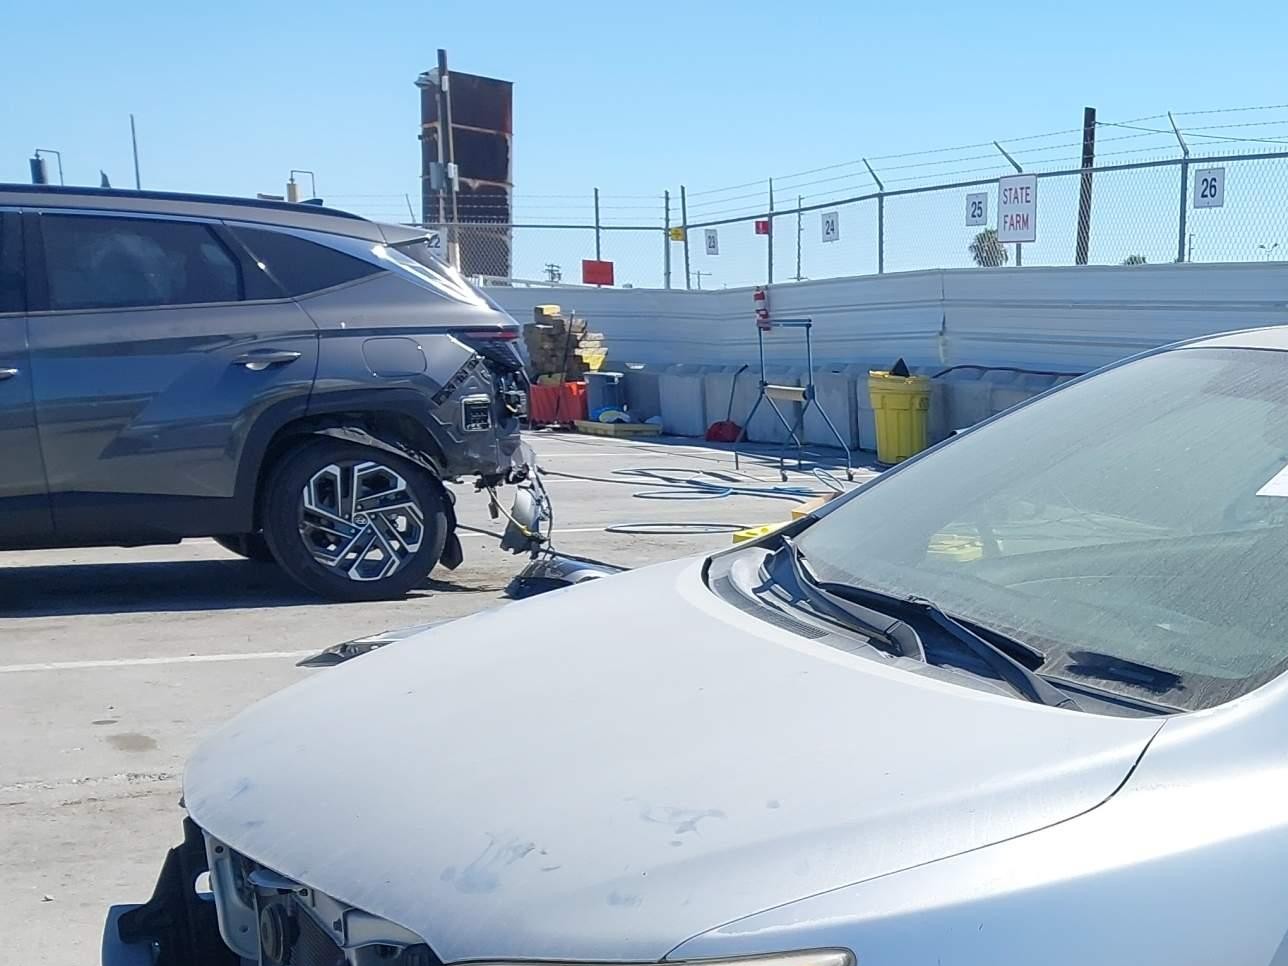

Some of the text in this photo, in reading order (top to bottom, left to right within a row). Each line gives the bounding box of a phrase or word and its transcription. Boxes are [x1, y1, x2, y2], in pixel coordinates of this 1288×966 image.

[1002, 186, 1032, 205] STATE
[1200, 177, 1217, 199] 26
[970, 200, 983, 218] 25
[824, 219, 835, 236] 24
[1003, 213, 1030, 232] FARM
